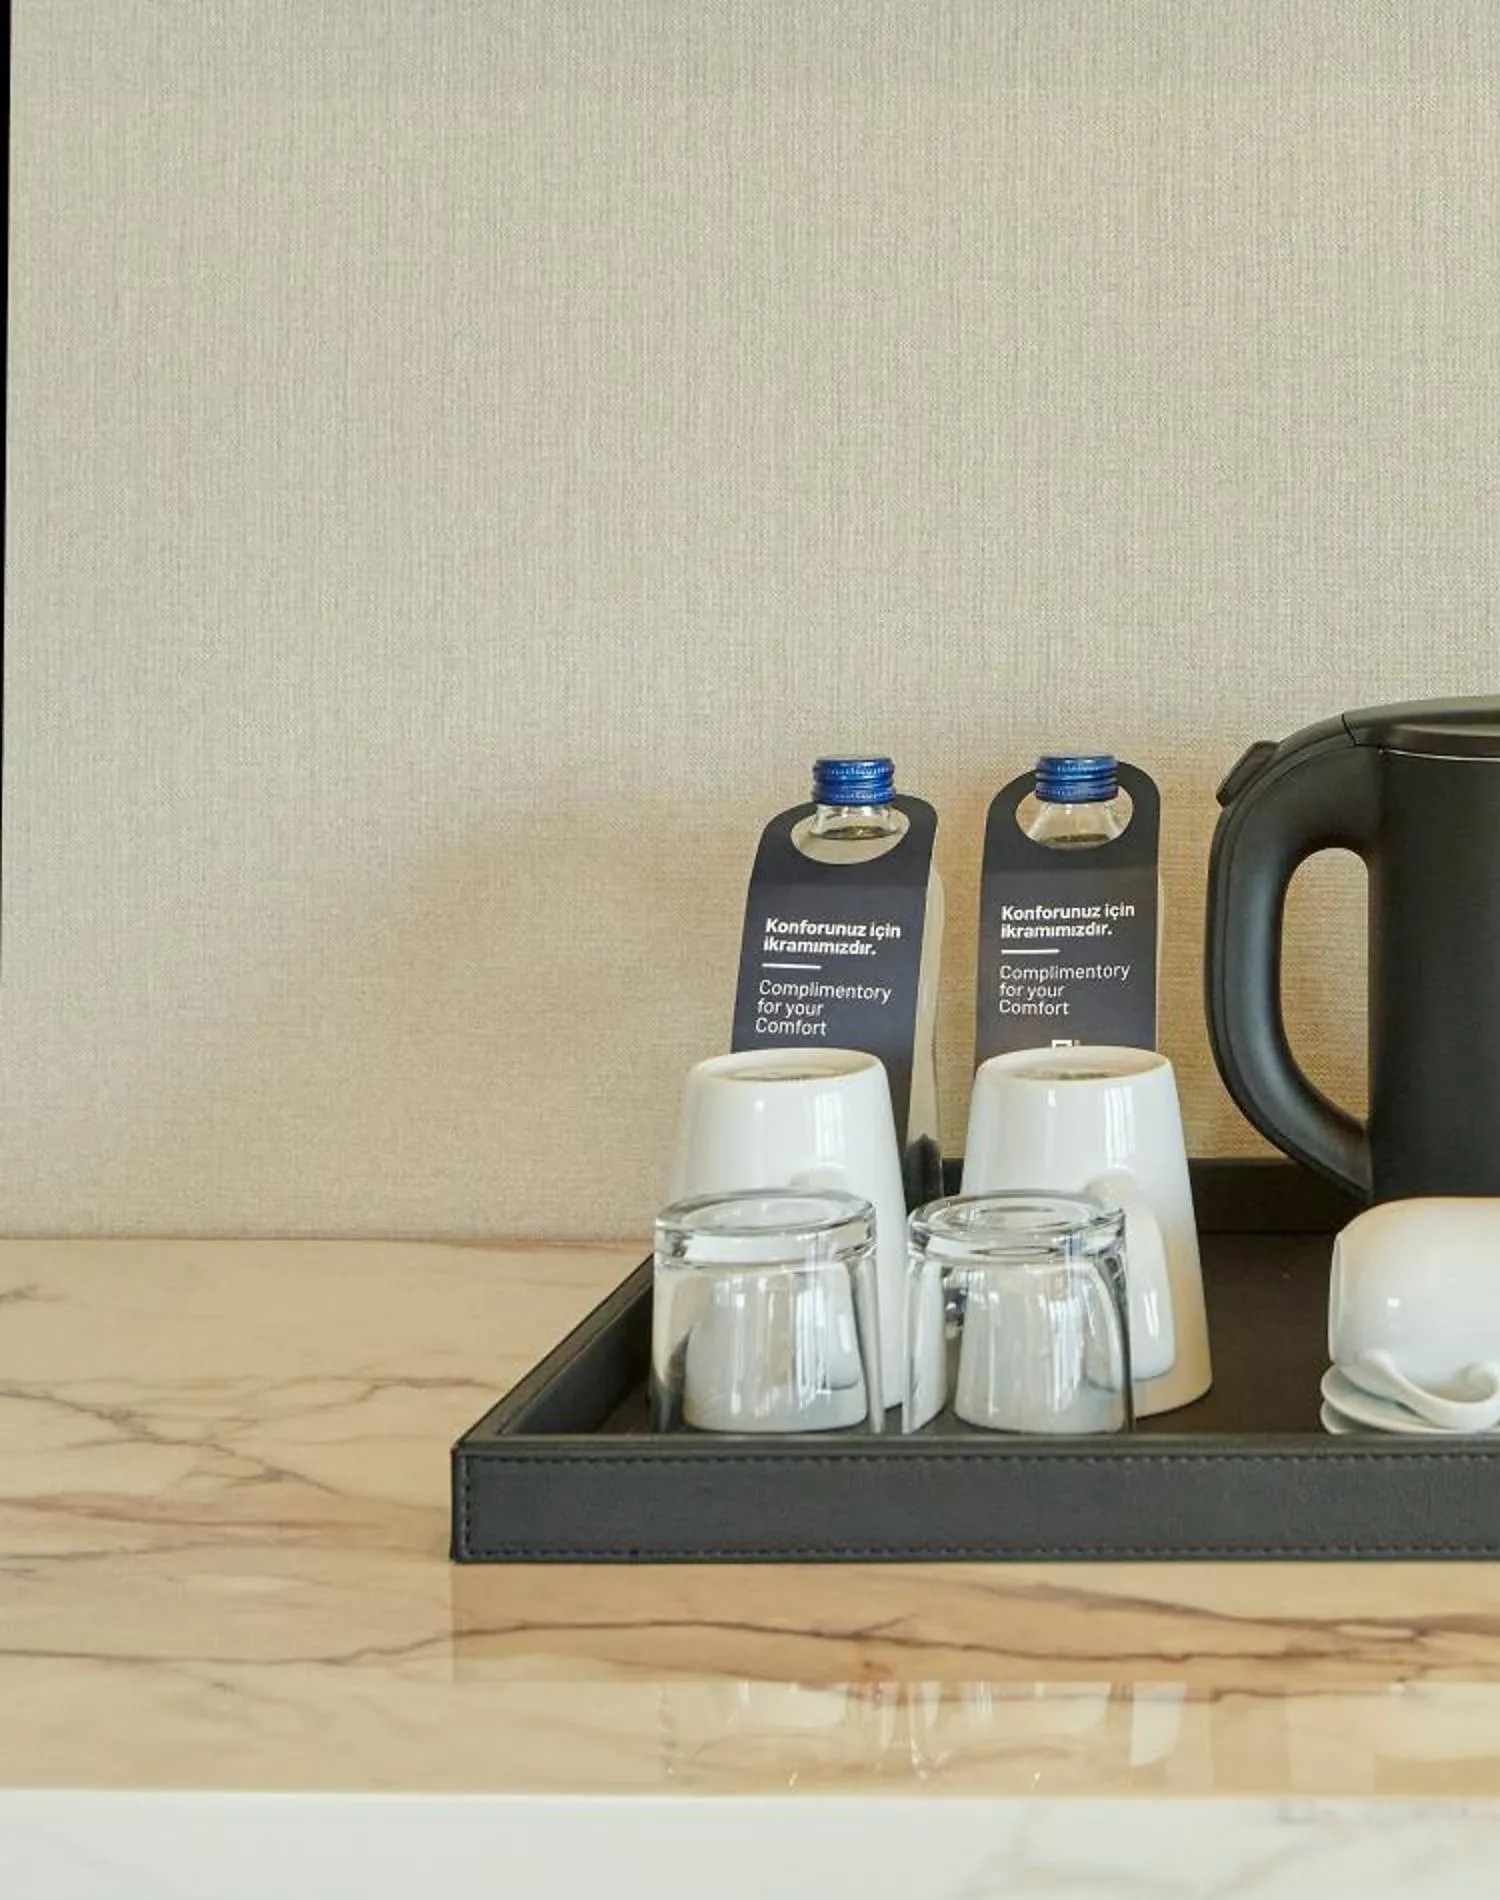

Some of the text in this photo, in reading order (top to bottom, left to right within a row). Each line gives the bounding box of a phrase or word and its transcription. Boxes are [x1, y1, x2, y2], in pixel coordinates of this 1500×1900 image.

[1001, 903, 1135, 921] Konforunuz için
[765, 918, 901, 940] Konforunuz için
[1001, 922, 1113, 939] ikramımızdır.
[763, 936, 877, 955] ikramımızdır.
[999, 964, 1131, 982] Complimentory
[759, 979, 892, 1004] Complimentory
[999, 982, 1066, 1001] for your
[757, 998, 824, 1018] for your
[999, 999, 1070, 1015] Comfort
[755, 1017, 827, 1036] Comfort
